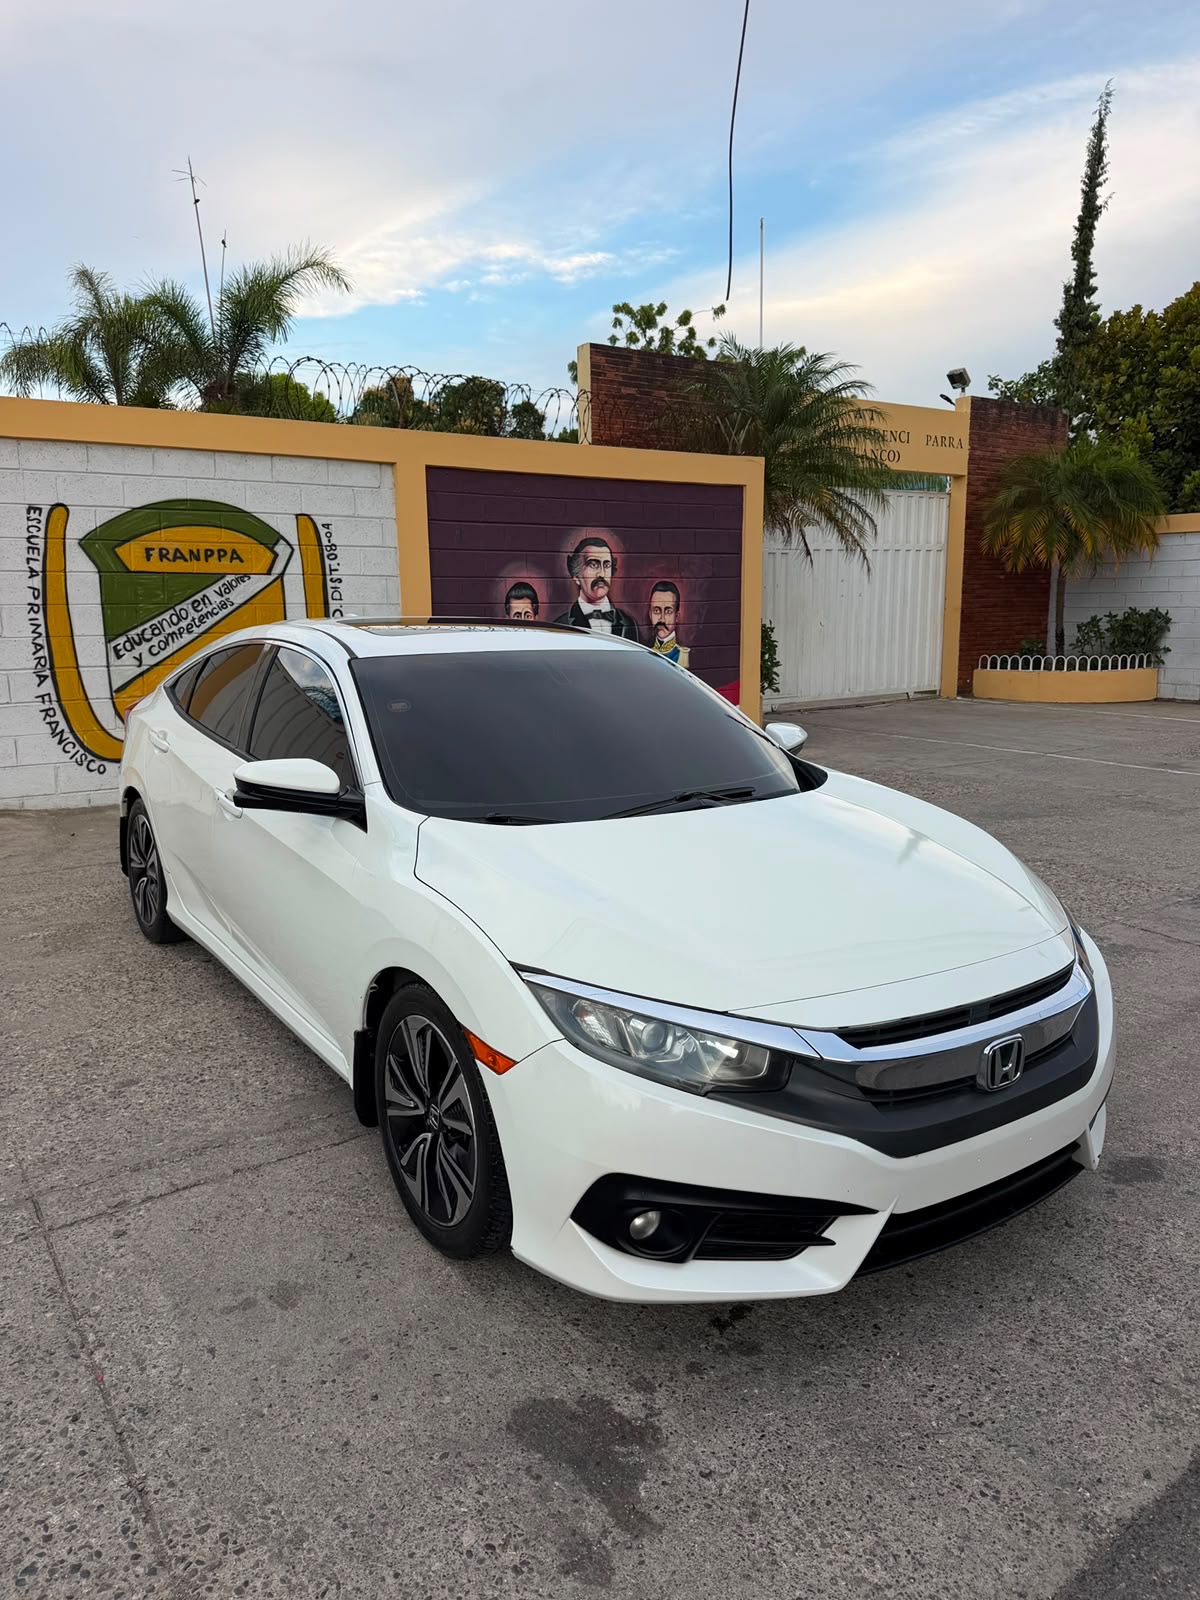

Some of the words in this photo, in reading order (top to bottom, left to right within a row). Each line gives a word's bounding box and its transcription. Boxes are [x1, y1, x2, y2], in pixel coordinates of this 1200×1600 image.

[925, 434, 964, 449] PARRA
[144, 547, 244, 563] FRANPPA
[26, 505, 42, 579] ESCUELA
[35, 692, 106, 774] FRANCISCO
[112, 606, 189, 660] Educando
[191, 594, 213, 613] en
[213, 574, 252, 598] valores
[133, 652, 143, 668] y
[148, 597, 235, 657] competencias
